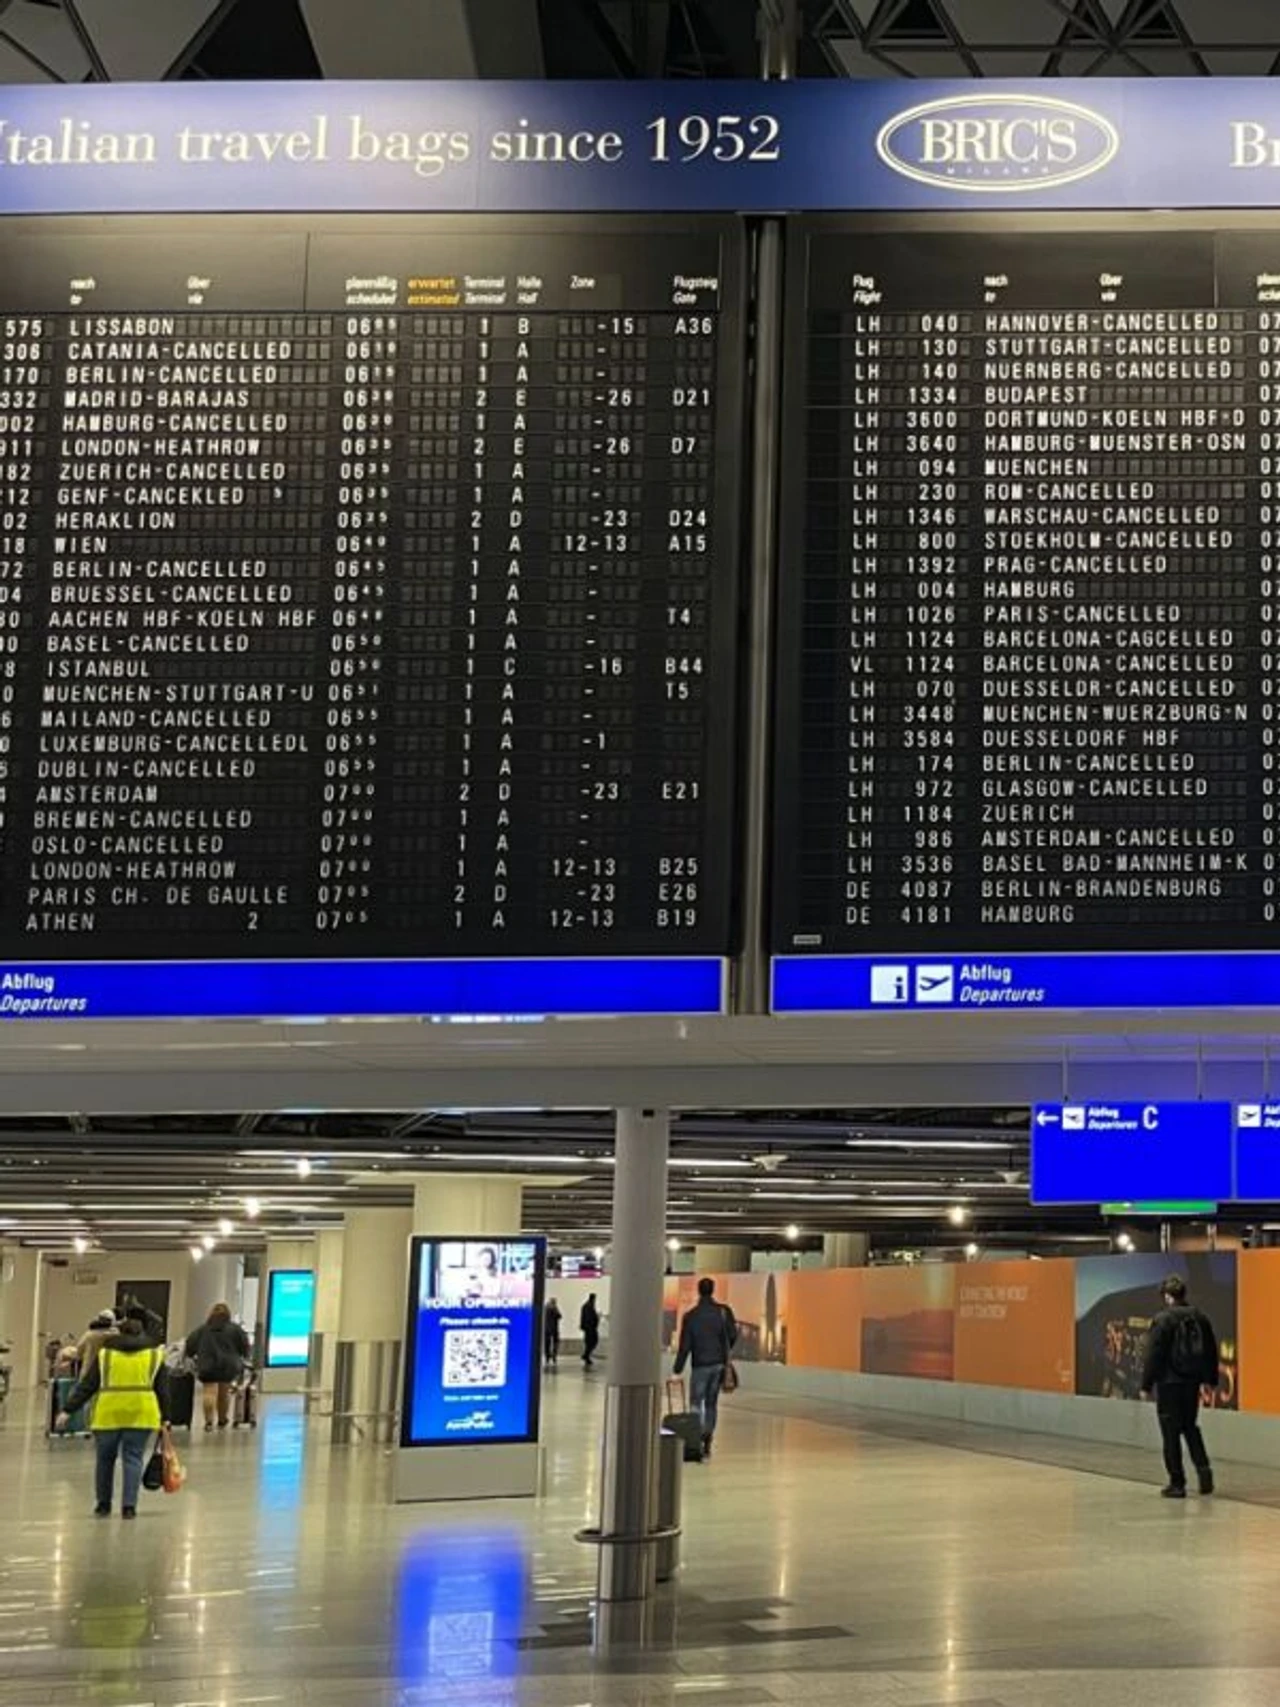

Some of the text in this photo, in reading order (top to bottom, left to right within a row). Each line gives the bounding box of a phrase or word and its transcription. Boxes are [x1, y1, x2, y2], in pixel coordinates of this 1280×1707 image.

[175, 115, 329, 162] travel
[347, 115, 470, 177] bags
[489, 118, 623, 161] since
[646, 115, 780, 161] 1952
[919, 118, 1077, 163] BRIC'S
[569, 275, 595, 289] Zone
[853, 274, 874, 289] Flug
[672, 292, 697, 304] Gate
[70, 318, 711, 336] LISSABON A36
[856, 314, 1218, 332] LH 040 HANNOVER-CANCELLED
[68, 344, 291, 360] CATANIA-CANCELLED
[985, 339, 1230, 355] STUTTGART-CANCELLED
[67, 368, 277, 383] BERLIN-CANCELLED
[985, 363, 1231, 379] NUERNBERG-CANCELLED
[65, 390, 710, 407] MADRID-BARAJAS D21
[985, 387, 1087, 403] BUDAPEST
[63, 415, 287, 431] HAMBURG-CANCELLED
[62, 439, 259, 455] LONDON-HEATHROW
[985, 435, 1246, 451] HAMBURG-MUENSTER-OSN
[60, 464, 285, 479] ZUERICH-CANCELLED
[984, 459, 1088, 476] MUENCHEN
[984, 484, 1154, 501] ROM-CANCELLED
[56, 511, 706, 529] HERAKLION D24
[984, 508, 1219, 525] WARSCHAU-CANCELLED
[54, 537, 107, 553] WIEN
[53, 562, 266, 578] BERLIN-CANCELLED
[984, 556, 1167, 574] PRAG-CANCELLED
[51, 586, 291, 602] BRUESSEL-CANCELLED
[984, 581, 1075, 598] HAMBURG
[49, 611, 128, 627] AACHEN
[279, 611, 317, 626] HBF
[984, 605, 1180, 622] PARIS-CANCELLED
[48, 636, 249, 652] BASEL-CANCELLED
[48, 658, 703, 676] ISTANBUL B44
[983, 656, 1233, 672] BARCELONA-CANCELLED
[983, 680, 1234, 697] DUESSELDR-CANCELLED
[42, 710, 270, 727] MAILAND-CANCELLED
[983, 704, 1247, 721] MUENCHEN-WUERZBURG-N
[41, 735, 308, 752] LUXEMBURG-CANCELLEDL
[983, 729, 1180, 747] DUESSELDORF HBF
[38, 760, 255, 777] DUBLIN-CANCELLED
[983, 754, 1195, 771] BERLIN-CANCELLED
[37, 785, 157, 802] AMSTERDAM
[982, 779, 1208, 796] GLASGOW-CANCELLED
[34, 811, 252, 828] BREMEN-CANCELLED
[982, 805, 1075, 822] ZUERICH
[32, 836, 223, 853] OSLO-CANCELLED
[982, 829, 1234, 847] AMSTERDAM-CANCELLED
[30, 862, 236, 879] LONDON-HEATHROW
[982, 854, 1247, 873] BASEL BAD-MANNHEIM-K
[28, 888, 95, 905] PARIS
[167, 887, 191, 903] DE
[209, 887, 288, 903] GAULLE
[982, 880, 1221, 898] BERLIN-BRANDENBURG
[26, 914, 94, 931] ATHEN
[981, 906, 1074, 923] HAMBURG
[960, 964, 1011, 984] Abflug
[1, 973, 54, 993] Abflug
[0, 994, 87, 1014] Departures
[960, 986, 1044, 1005] Departures
[1142, 1105, 1158, 1130] C
